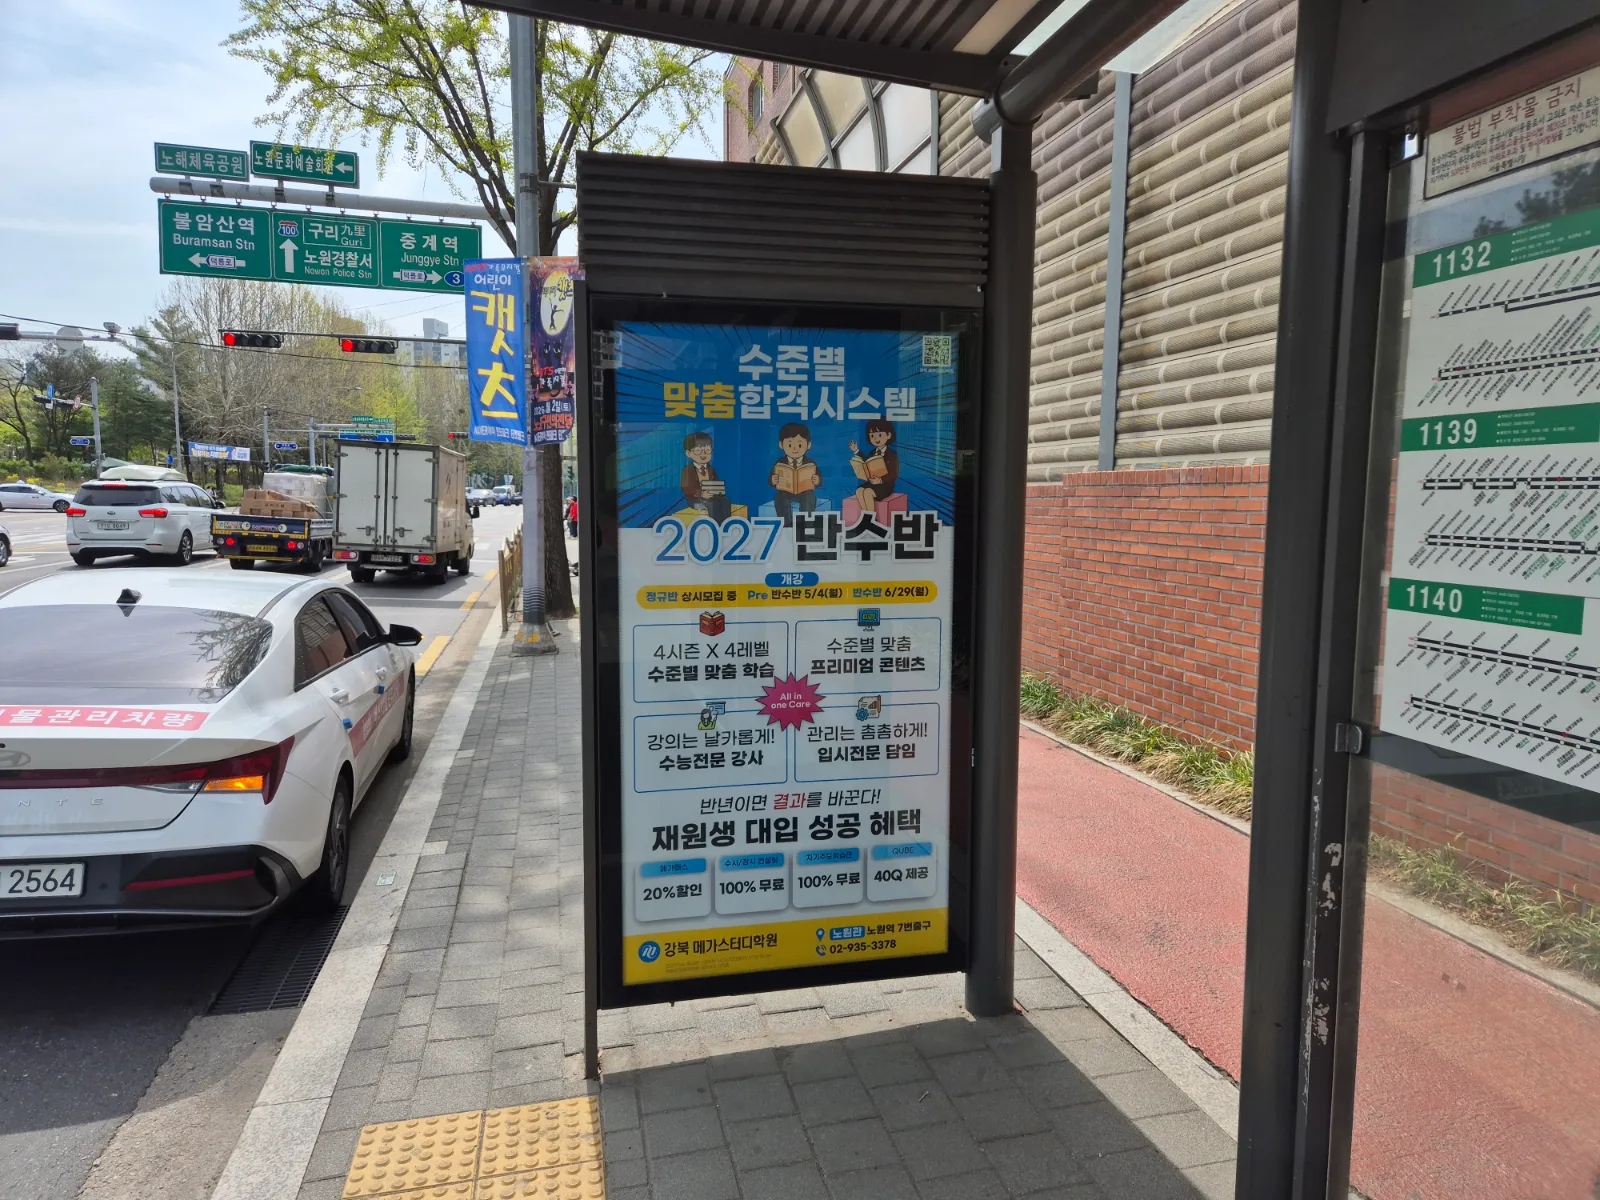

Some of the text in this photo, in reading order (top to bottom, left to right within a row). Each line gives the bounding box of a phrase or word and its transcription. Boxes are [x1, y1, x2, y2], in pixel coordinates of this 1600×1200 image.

[1452, 77, 1581, 145] 불법 부착물 금지
[161, 150, 243, 174] 노해체육공원
[172, 211, 255, 236] 불암산역
[281, 226, 296, 235] 100
[308, 222, 339, 241] 구리
[341, 224, 366, 237] 九里
[173, 233, 255, 250] Buramsan Stn
[341, 237, 363, 247] Guri
[400, 232, 458, 253] 중계역
[304, 249, 373, 270] 노원경찰서
[401, 252, 459, 267] Junggye Stn
[1433, 241, 1491, 278] 1132
[304, 266, 372, 279] Nowon Police Stn
[452, 273, 461, 284] 3
[474, 273, 512, 291] 어린이
[470, 290, 519, 419] 캣츠
[738, 343, 845, 382] 수준별
[663, 381, 917, 422] 맞춤합격시스템
[1419, 418, 1478, 446] 1139
[654, 513, 940, 563] 2027 반수반
[781, 573, 804, 585] 개강
[646, 586, 929, 602] 정규반 상시모집 중 Pre 반수반 5/4(월) 반수반 6/29(월)
[1406, 584, 1463, 613] 1140
[653, 641, 769, 660] 4시즌 X 4레벨
[827, 636, 911, 654] 수준별 맞춤
[648, 662, 775, 682] 수준별 맞춤 학습
[811, 656, 926, 674] 프리미엄 콘텐츠
[788, 700, 811, 708] Care
[794, 692, 802, 700] in
[0, 709, 194, 727] 물관리차량
[648, 728, 775, 751] 강의는 날카롭게!
[807, 722, 928, 742] 관리는 촘촘하게!
[659, 750, 764, 771] 수능전문 강사
[818, 743, 916, 763] 입시전문 담임
[700, 789, 882, 815] 반년이면 결과를 바꾼다!
[652, 808, 922, 851] 재원생 대입 성공 혜택
[892, 846, 914, 855] QUBE
[8, 868, 76, 893] 2564
[797, 872, 860, 889] 100% 무료
[874, 866, 929, 882] 40Q 제공
[719, 878, 785, 895] 100% 무료
[832, 920, 931, 939] 노원관 노원역 7번출구
[664, 933, 778, 958] 강북 메가스터디학원
[830, 939, 897, 954] 02-935-3378
